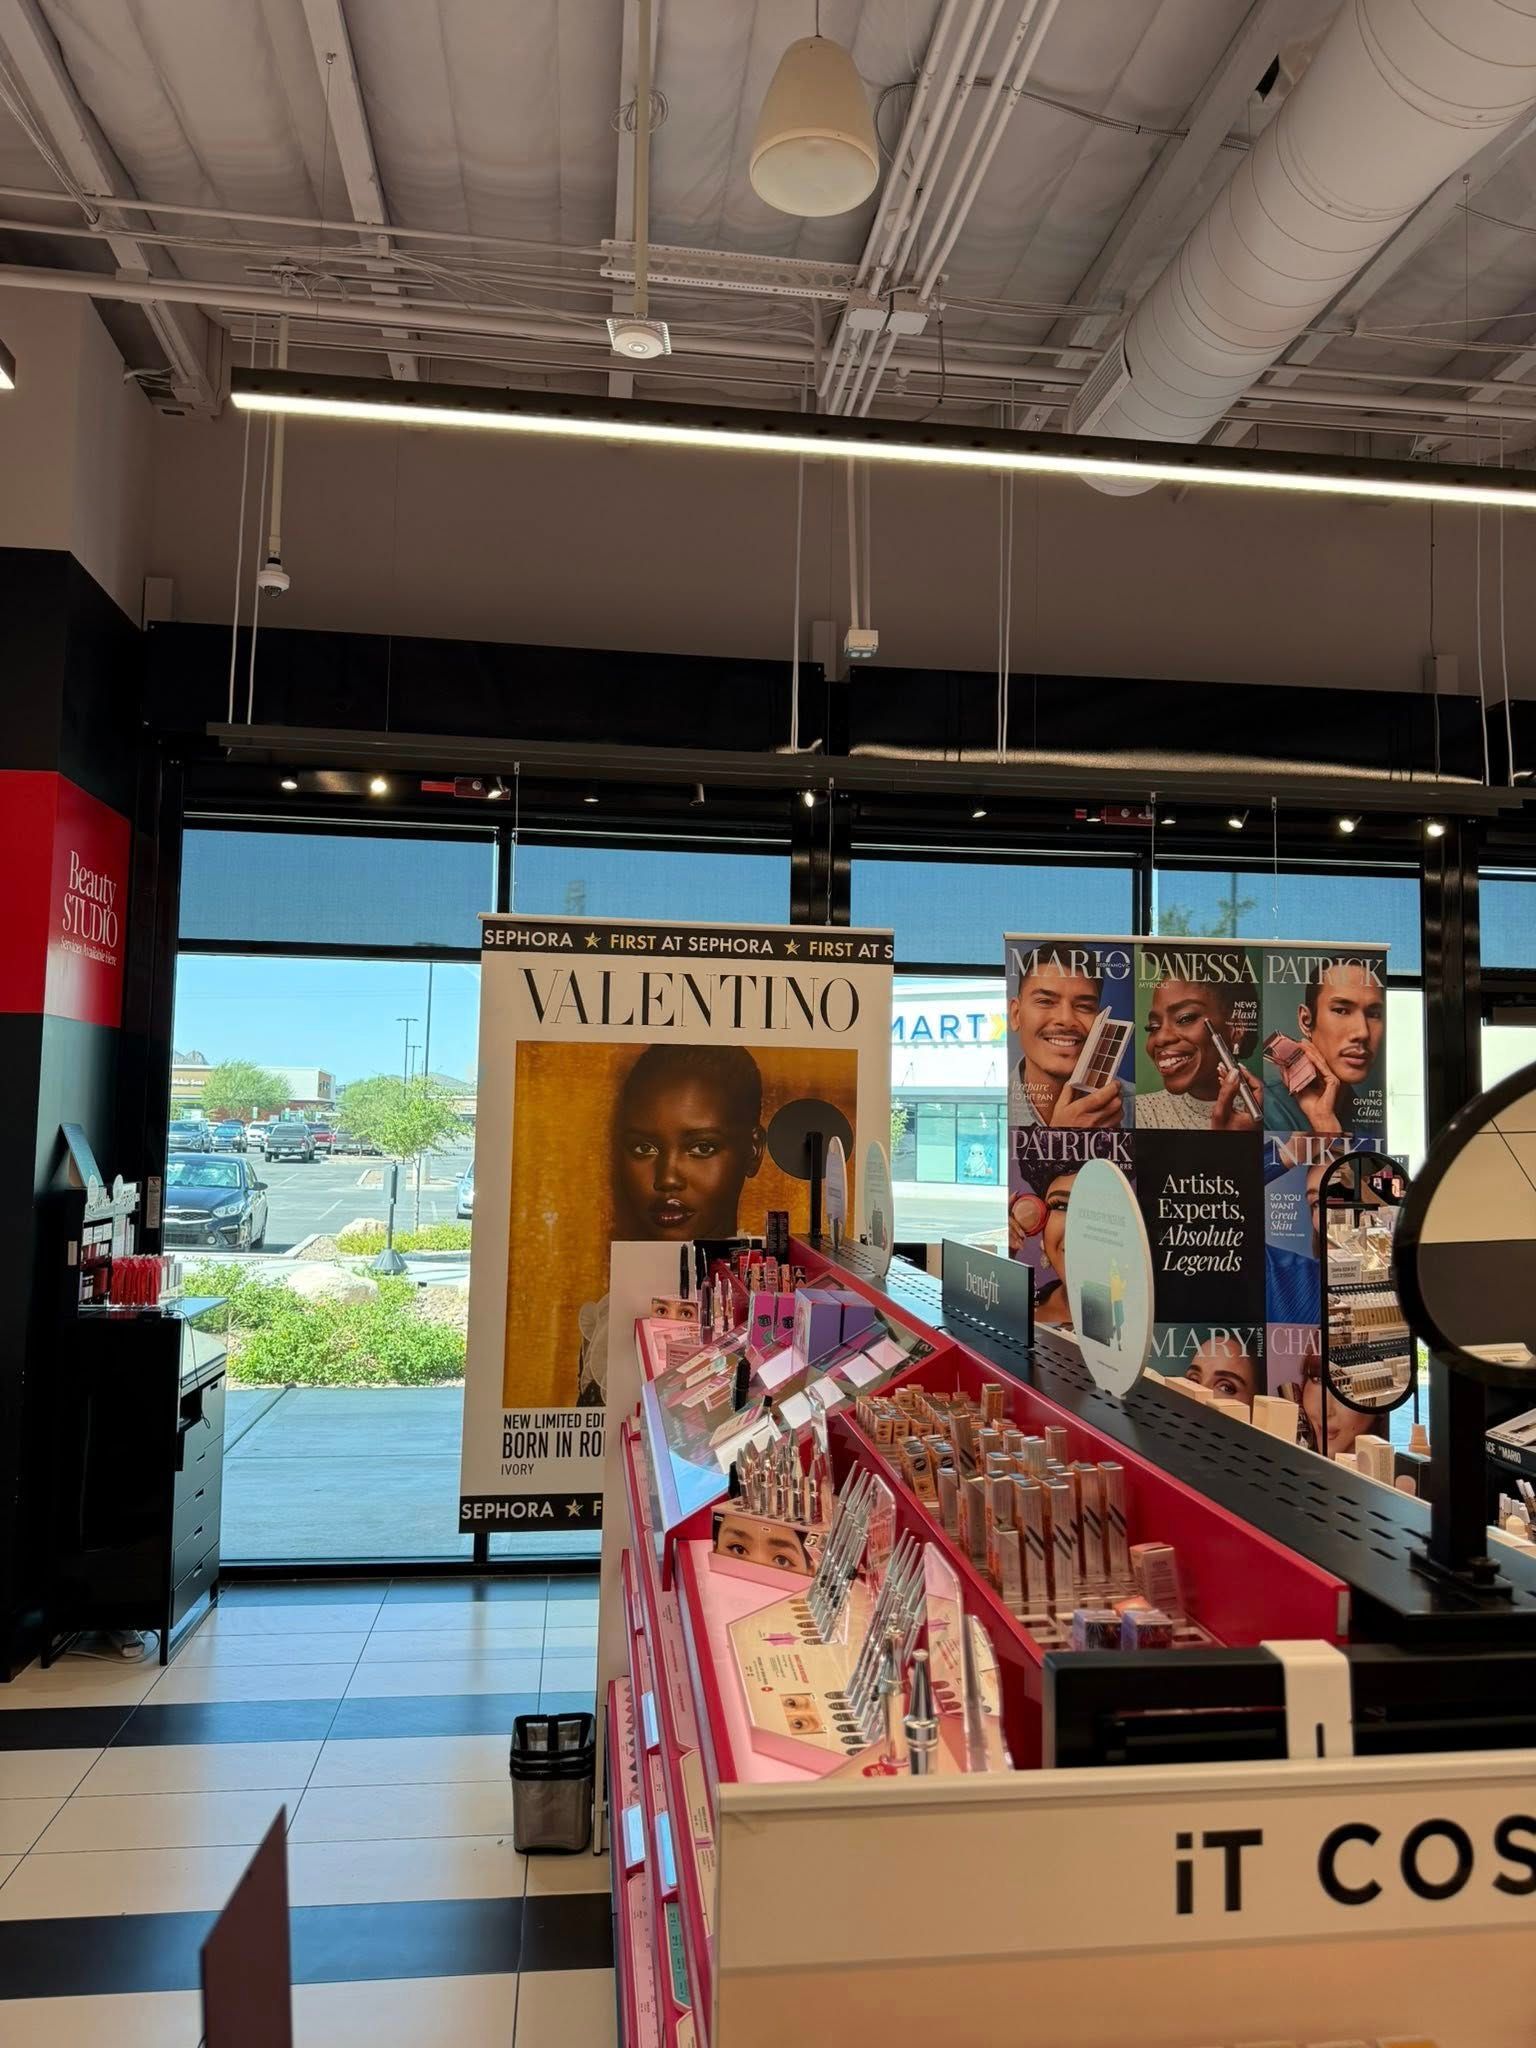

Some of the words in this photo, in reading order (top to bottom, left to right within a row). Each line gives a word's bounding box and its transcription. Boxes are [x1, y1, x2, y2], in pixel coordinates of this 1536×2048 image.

[69, 850, 117, 912] Beauty
[62, 892, 118, 948] STUDIO
[484, 929, 574, 948] SEPHORA
[610, 934, 657, 950] FIRST
[661, 936, 684, 951] AT
[688, 937, 774, 955] SEPHORA
[809, 941, 852, 957] FIRST
[858, 944, 881, 958] AT
[1009, 947, 1131, 980] MARIO
[1139, 951, 1260, 984] DANESSA
[1266, 955, 1384, 988] PATRICK
[517, 967, 860, 1033] VALENTINO
[1234, 1001, 1258, 1009] NEWS
[1231, 1008, 1257, 1020] Flash
[1011, 1080, 1050, 1093] Prepare
[1023, 1093, 1035, 1101] HIT
[1036, 1093, 1053, 1101] PAN
[1368, 1090, 1383, 1098] IT'S
[1352, 1098, 1383, 1106] GIVING
[1357, 1106, 1384, 1117] Glow
[1010, 1130, 1133, 1162] PATRICK
[1269, 1136, 1385, 1166] NIKKI
[1162, 1173, 1239, 1198] Artists,
[1283, 1194, 1301, 1202] YOU
[1158, 1198, 1245, 1224] Experts,
[1270, 1202, 1294, 1210] WANT
[1270, 1210, 1298, 1220] Great
[1158, 1224, 1244, 1247] Absolute
[1270, 1220, 1292, 1231] Skin
[1162, 1249, 1242, 1276] Legends
[965, 1261, 1000, 1311] benefit
[1148, 1327, 1256, 1359] MARY
[503, 1414, 531, 1429] NEW
[534, 1413, 581, 1429] LIMITED
[586, 1413, 607, 1428] EDI
[502, 1431, 549, 1459] BORN
[556, 1431, 572, 1458] IN
[580, 1430, 606, 1458] RO
[501, 1463, 535, 1476] IVORY
[461, 1501, 555, 1520] SEPHORA
[1176, 1829, 1263, 1915] iT
[1317, 1813, 1536, 1906] COS
